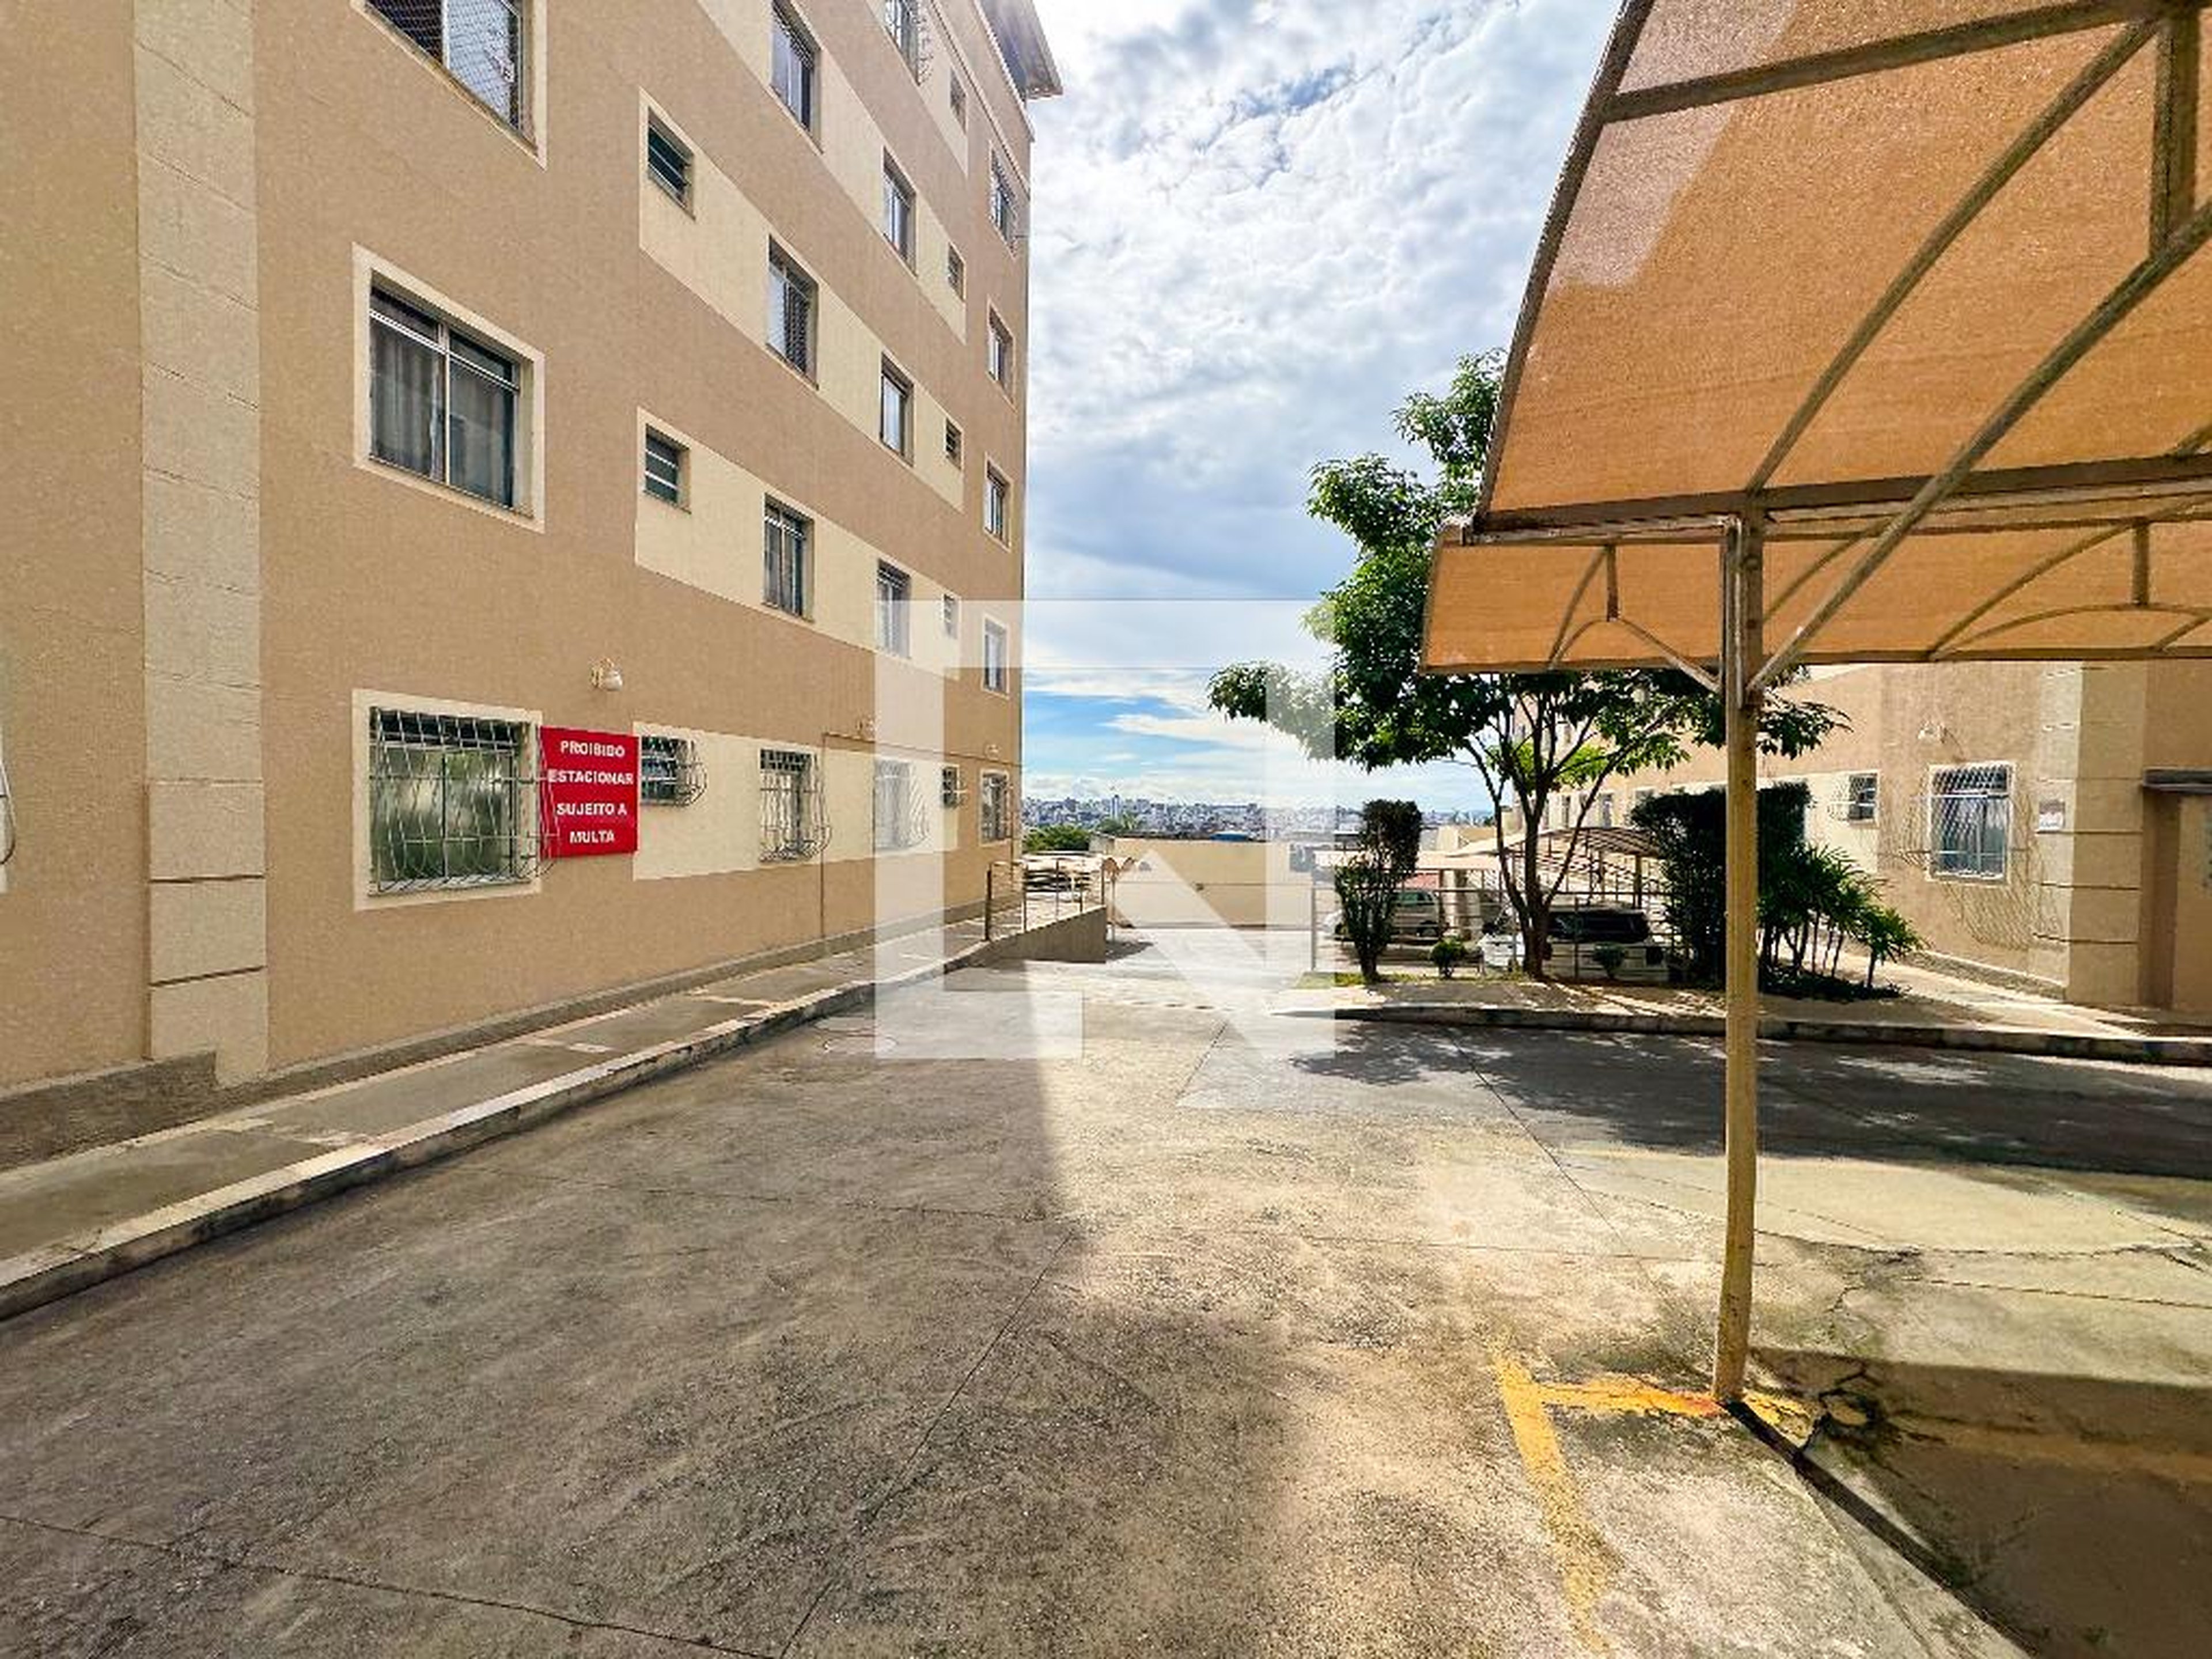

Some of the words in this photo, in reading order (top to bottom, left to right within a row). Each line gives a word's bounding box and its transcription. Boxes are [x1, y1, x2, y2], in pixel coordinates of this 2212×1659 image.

[560, 740, 626, 757] PROIBIDO
[548, 768, 634, 785] ESTACIONAR
[556, 802, 615, 816] SUJEITO
[618, 802, 627, 816] A
[569, 829, 615, 844] MULTA
